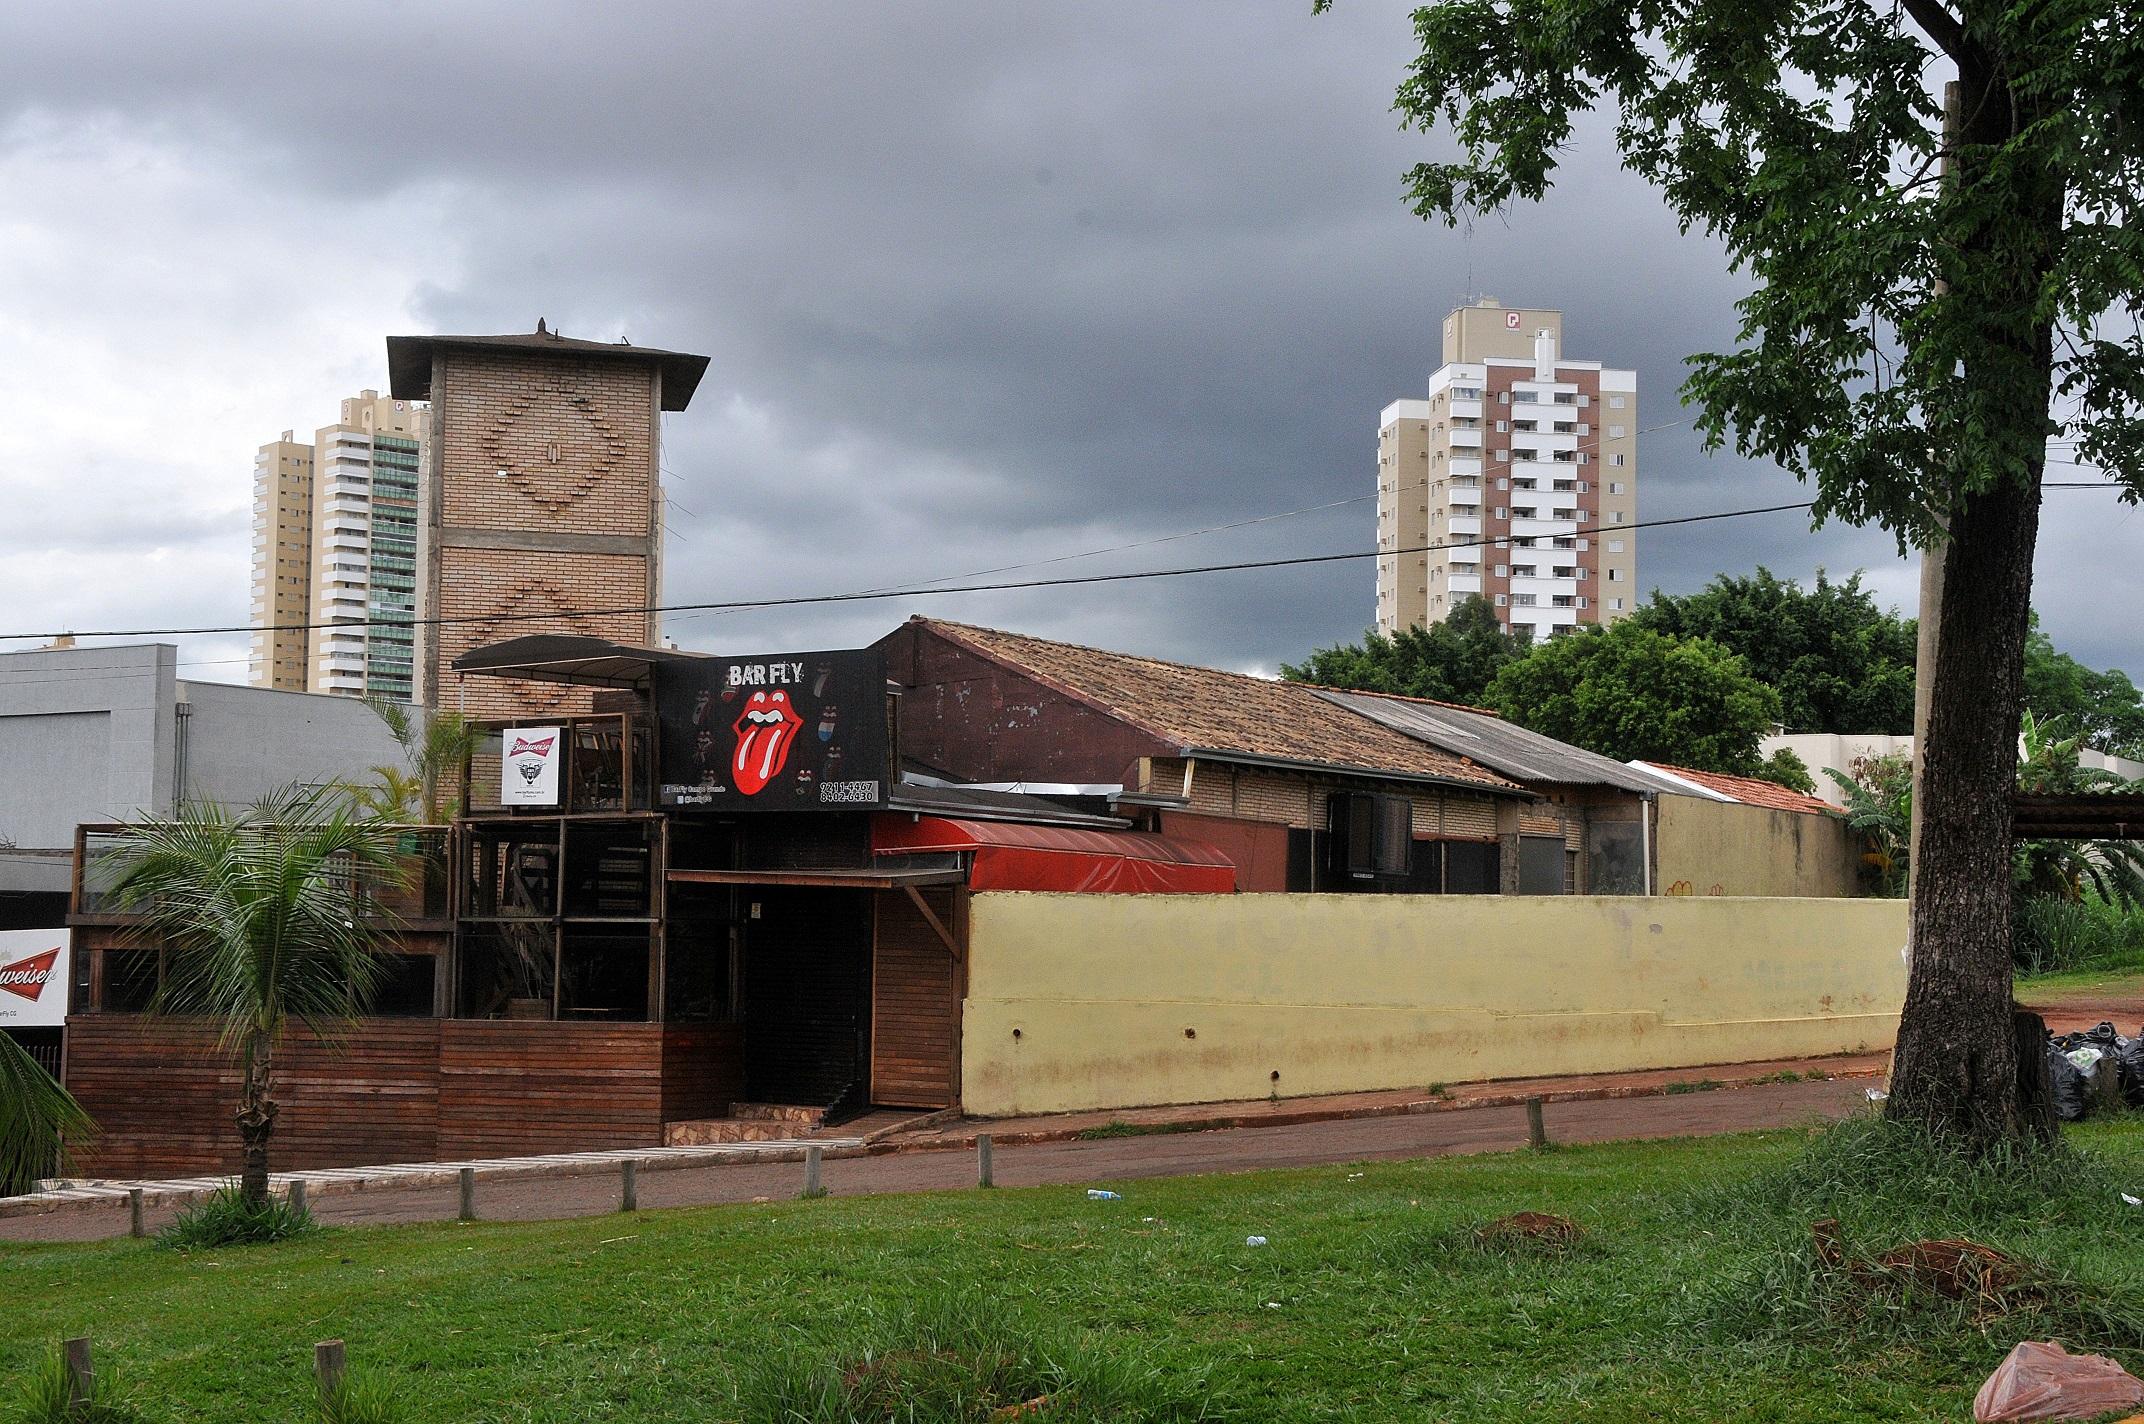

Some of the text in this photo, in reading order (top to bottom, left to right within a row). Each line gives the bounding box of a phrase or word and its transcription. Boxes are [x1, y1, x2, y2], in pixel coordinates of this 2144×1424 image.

[730, 662, 803, 686] BAR FLY
[820, 782, 872, 791] 9211-4467
[820, 791, 873, 802] 8402-6430
[0, 963, 57, 985] weiser
